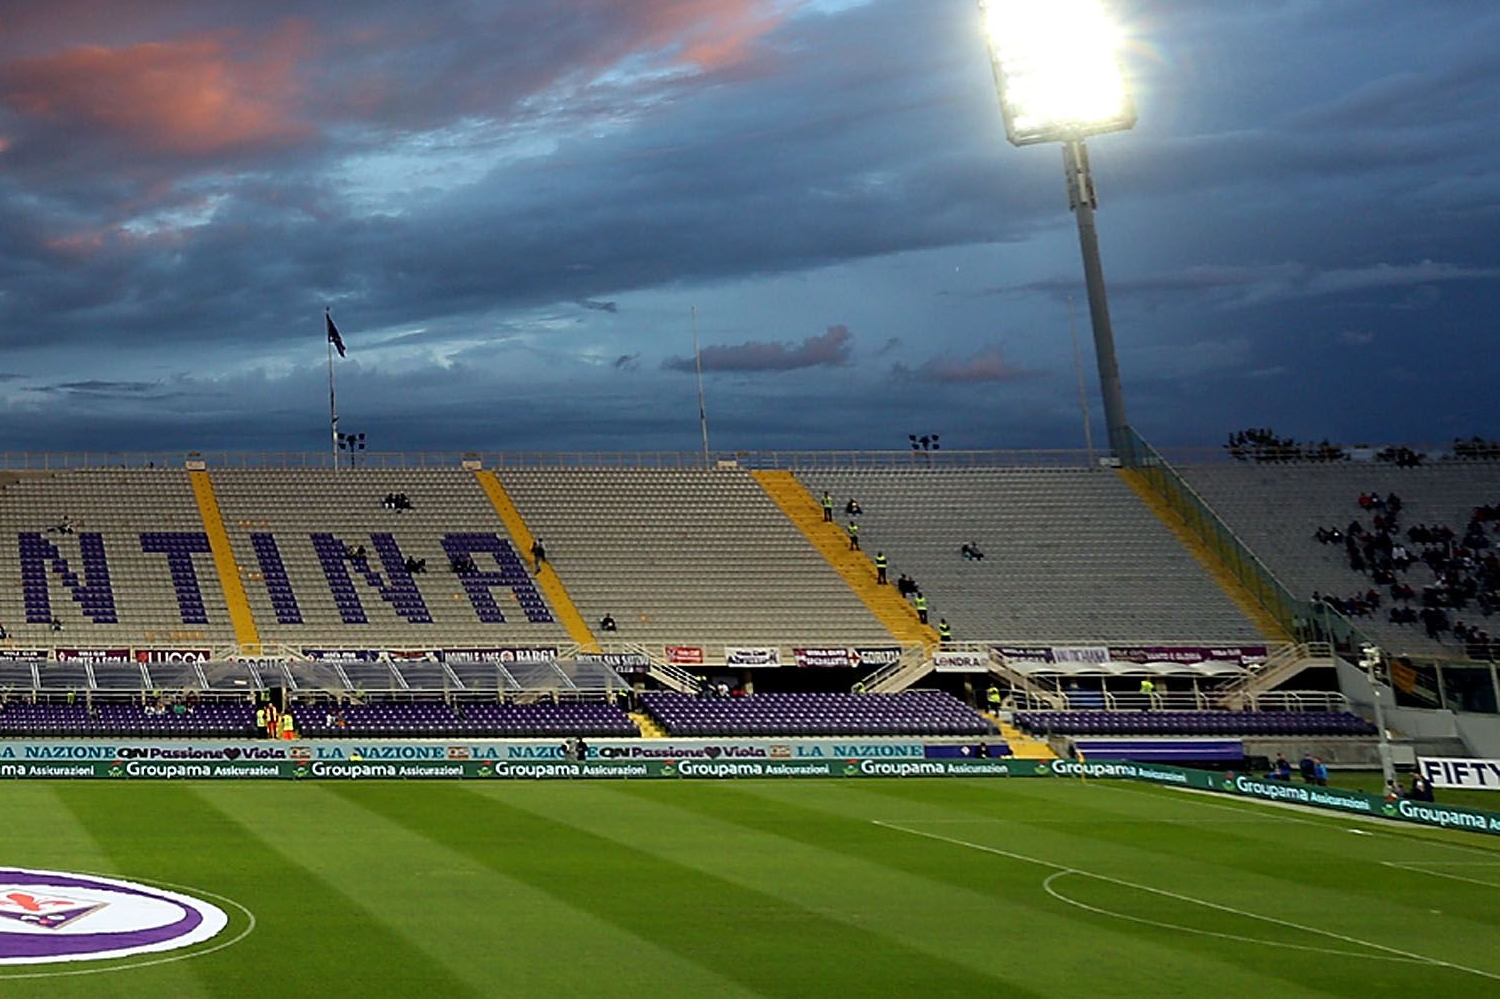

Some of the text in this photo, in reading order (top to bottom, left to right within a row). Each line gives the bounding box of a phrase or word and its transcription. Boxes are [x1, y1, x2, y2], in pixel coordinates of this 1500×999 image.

[25, 747, 116, 759] NAZIONE
[151, 748, 223, 759] Passione
[243, 747, 285, 759] Viola
[317, 747, 444, 758] LA NAZIONE
[473, 747, 499, 758] LA
[632, 747, 704, 758] Passione
[723, 747, 765, 756] Viola
[796, 745, 923, 757] LA NAZIONE
[29, 766, 94, 776] Assicurazioni
[126, 762, 278, 777] Groupama Assicurazioni
[312, 762, 463, 778] Groupama Assicurazioni
[496, 762, 647, 778] Groupama Assicurazioni
[679, 762, 830, 775] Groupama Assicurazioni
[861, 760, 945, 775] Groupama
[1052, 760, 1136, 777] Groupama
[1237, 776, 1370, 811] Groupama Assicurazioni
[1399, 800, 1487, 829] Groupama
